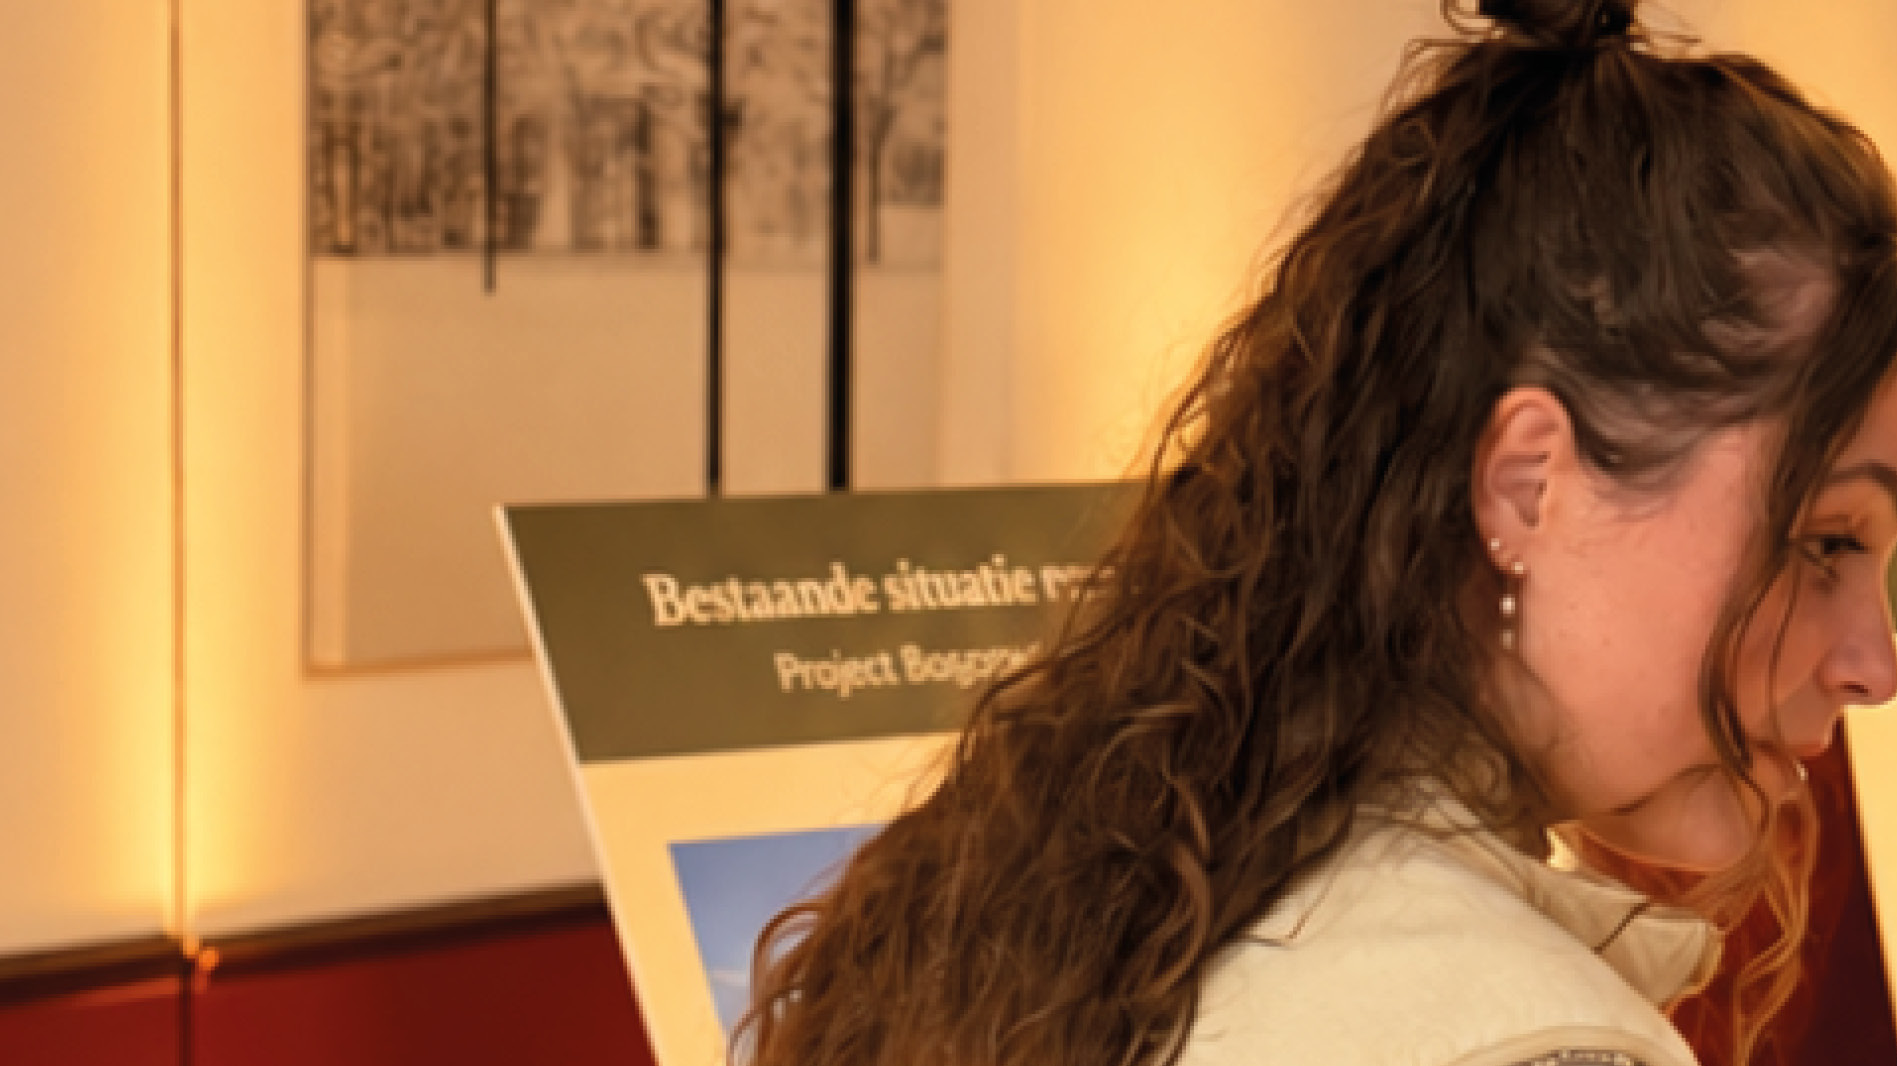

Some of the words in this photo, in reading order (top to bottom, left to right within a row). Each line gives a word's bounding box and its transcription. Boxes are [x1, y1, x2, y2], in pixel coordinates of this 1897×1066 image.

[641, 562, 877, 627] Bestaande
[883, 554, 1036, 611] situatie
[774, 649, 897, 697] Project
